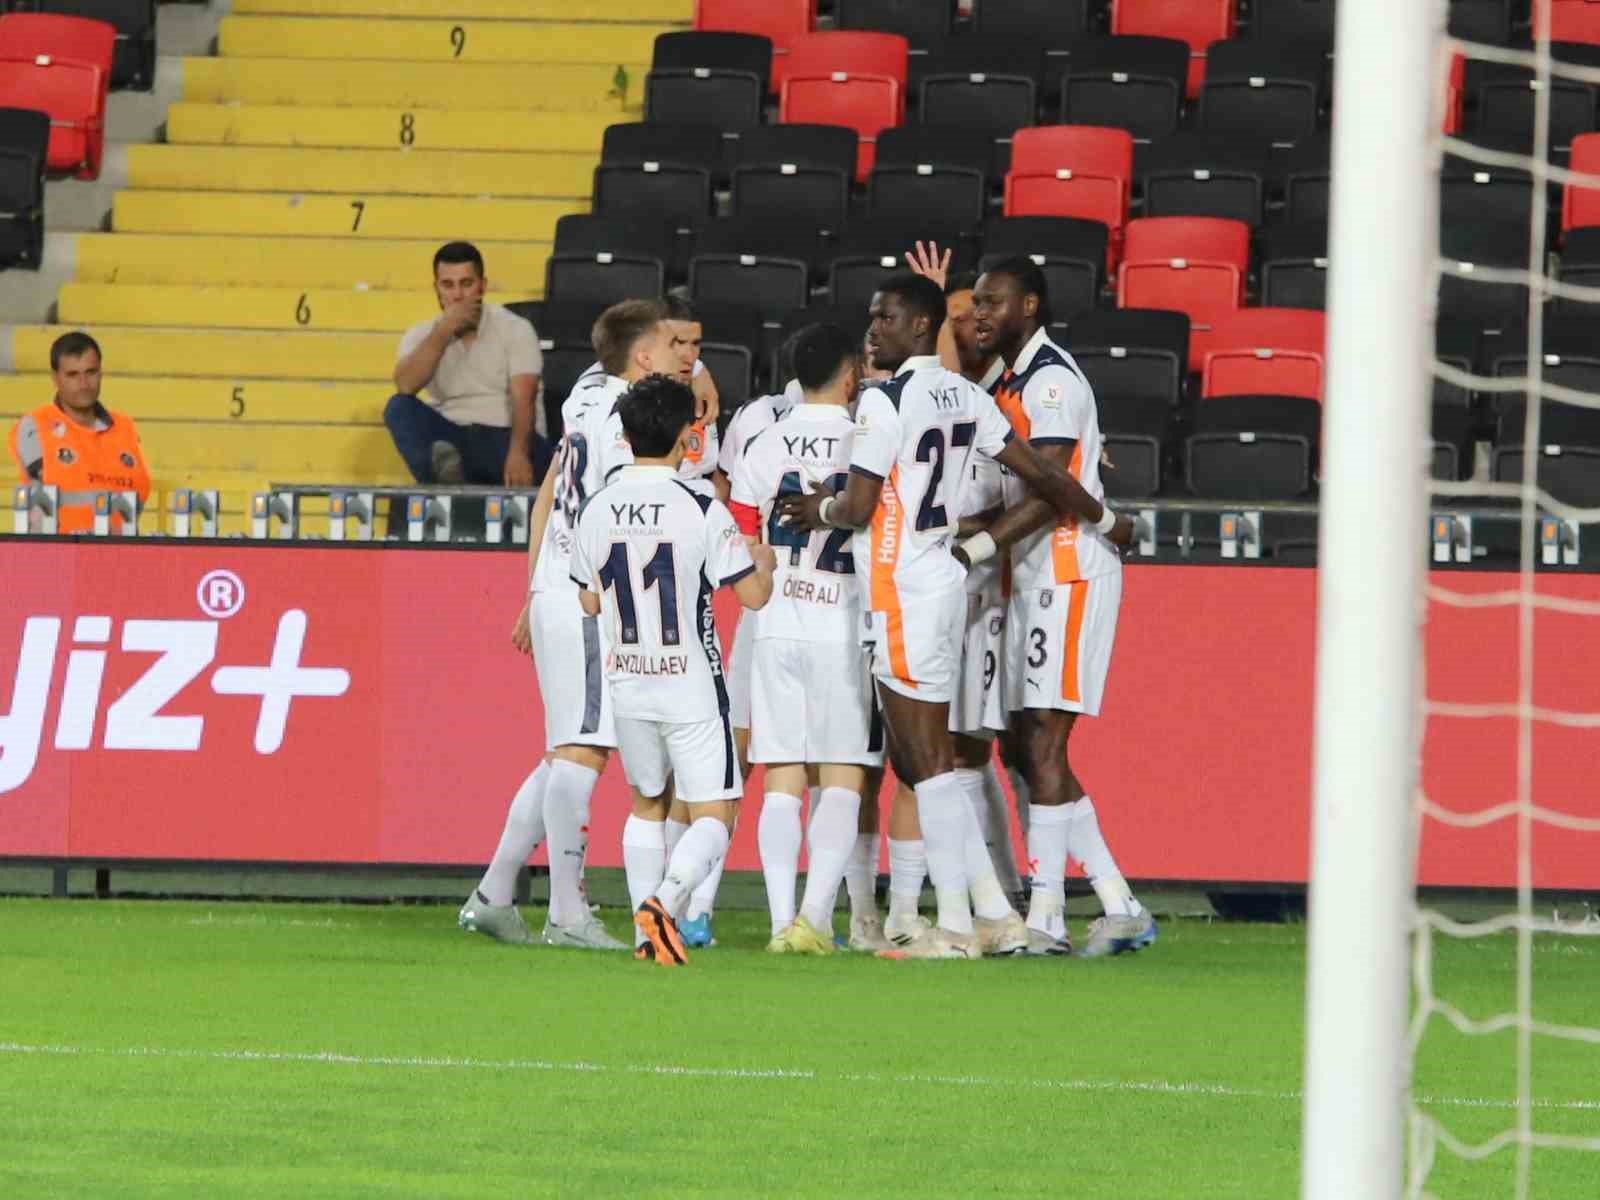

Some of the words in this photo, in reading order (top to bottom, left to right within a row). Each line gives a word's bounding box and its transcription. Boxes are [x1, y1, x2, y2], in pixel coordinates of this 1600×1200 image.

[450, 25, 466, 58] 9
[399, 112, 415, 146] 8
[351, 201, 365, 232] 7
[295, 293, 311, 326] 6
[229, 386, 246, 418] 5
[928, 386, 960, 410] YKT
[783, 435, 841, 459] YKT
[610, 503, 666, 526] YKT
[598, 541, 681, 647] 11
[1026, 627, 1048, 669] 3
[606, 654, 689, 676] AYZULLAEV
